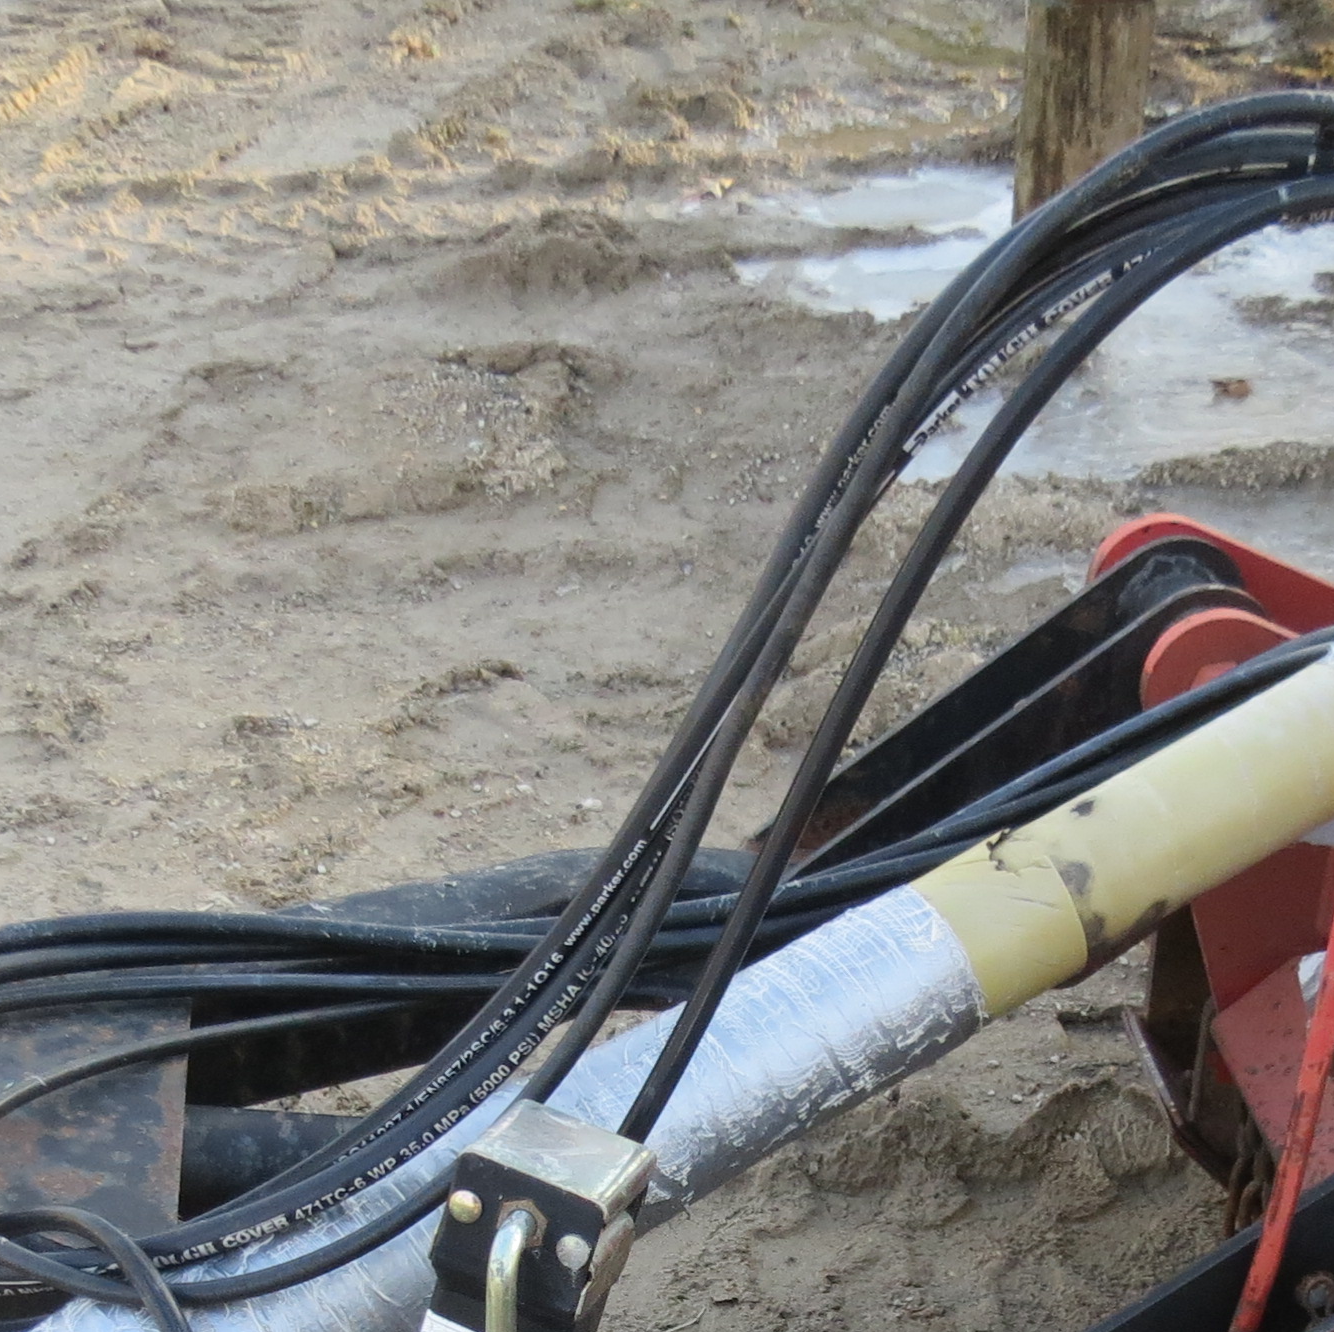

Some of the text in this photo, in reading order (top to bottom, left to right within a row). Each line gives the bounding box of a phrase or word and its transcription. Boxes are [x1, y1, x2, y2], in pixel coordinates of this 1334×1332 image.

[564, 839, 648, 947] www.parker.com
[221, 1213, 290, 1248] COVER
[294, 1177, 367, 1221] 471TC-6
[367, 1157, 397, 1181] WP
[399, 1132, 435, 1160] 35.0
[433, 1104, 471, 1134] MPa
[469, 1064, 511, 1104] (5000
[508, 1032, 541, 1066] PSI)
[537, 984, 582, 1033] MSHA
